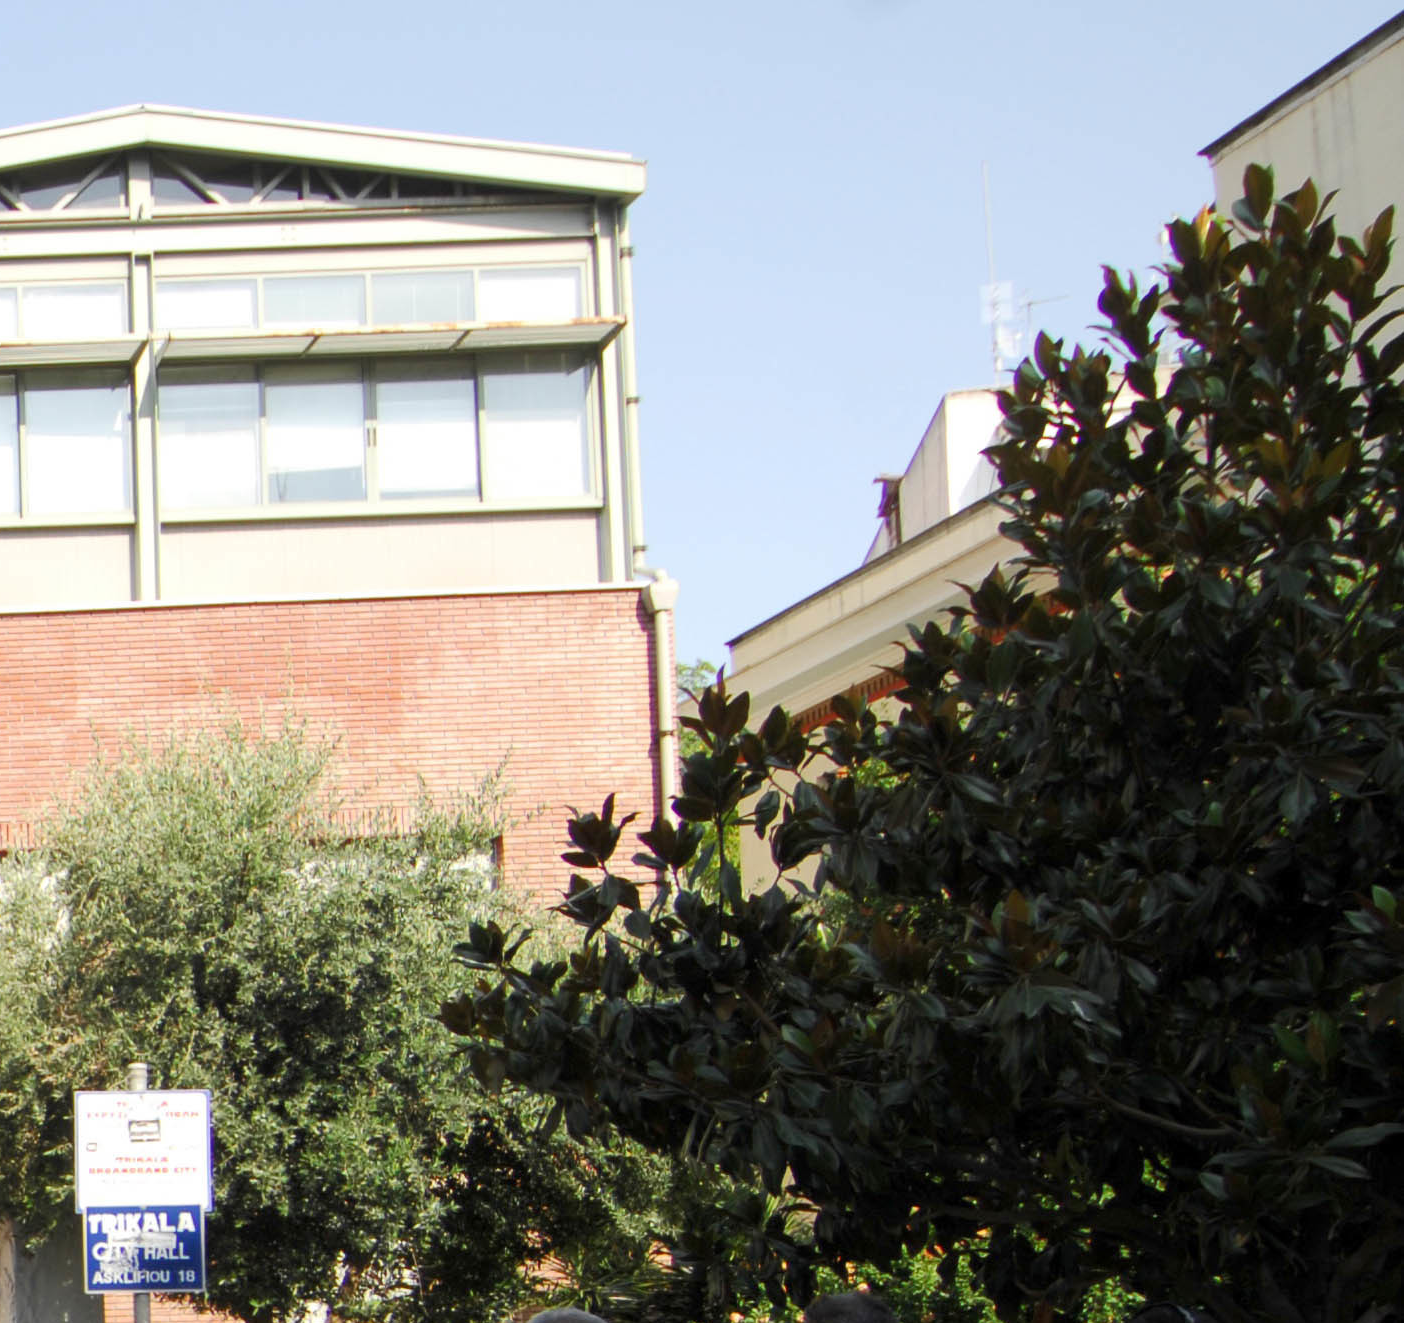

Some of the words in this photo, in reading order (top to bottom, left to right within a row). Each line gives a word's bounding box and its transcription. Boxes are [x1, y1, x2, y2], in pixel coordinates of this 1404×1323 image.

[88, 1212, 195, 1234] TRIKALA
[144, 1242, 190, 1260] HALL
[178, 1269, 195, 1282] 18
